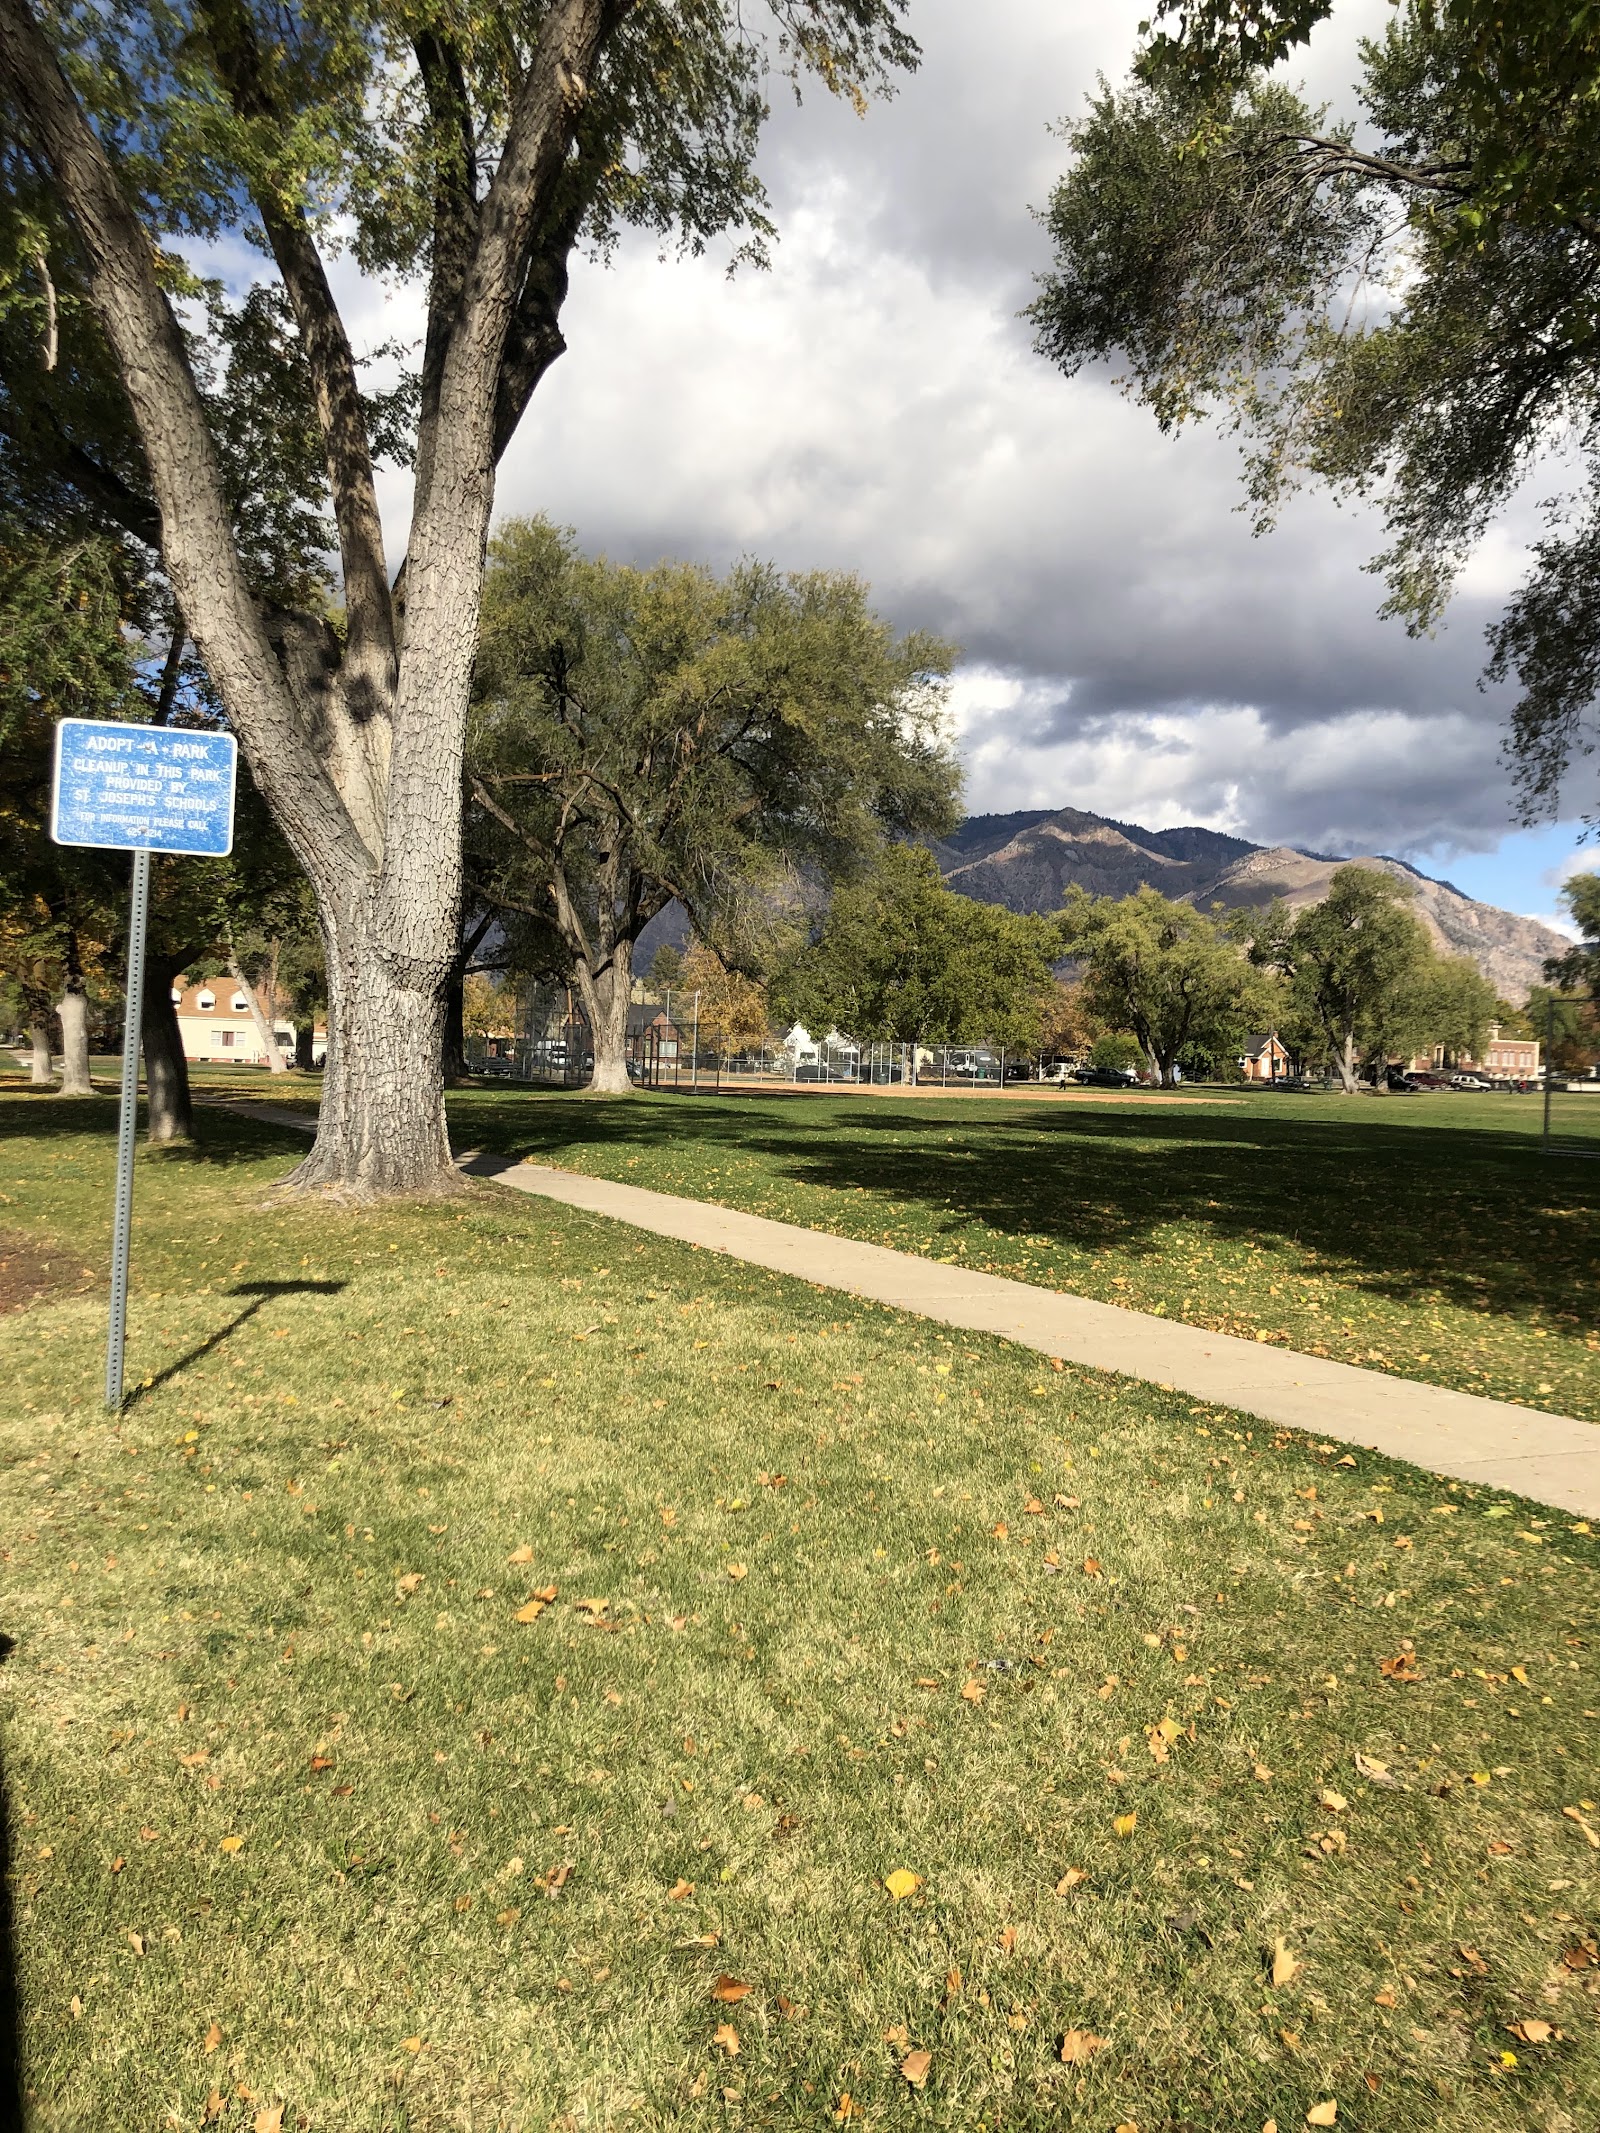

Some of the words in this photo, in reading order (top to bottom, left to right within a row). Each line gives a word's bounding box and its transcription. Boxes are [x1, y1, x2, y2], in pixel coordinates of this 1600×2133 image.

[74, 759, 129, 774] CLEANUP
[136, 764, 148, 775] IN
[157, 764, 182, 778] THIS
[191, 769, 220, 782] PARK
[106, 777, 162, 792] PROVIDED
[171, 782, 186, 793] BY
[100, 792, 156, 806] JOSEPH'S
[164, 797, 217, 811] SCHOOLS
[80, 812, 95, 821] FOR
[101, 814, 149, 825] INFORMATION
[154, 818, 184, 829] PLEASE
[188, 820, 208, 830] CALL
